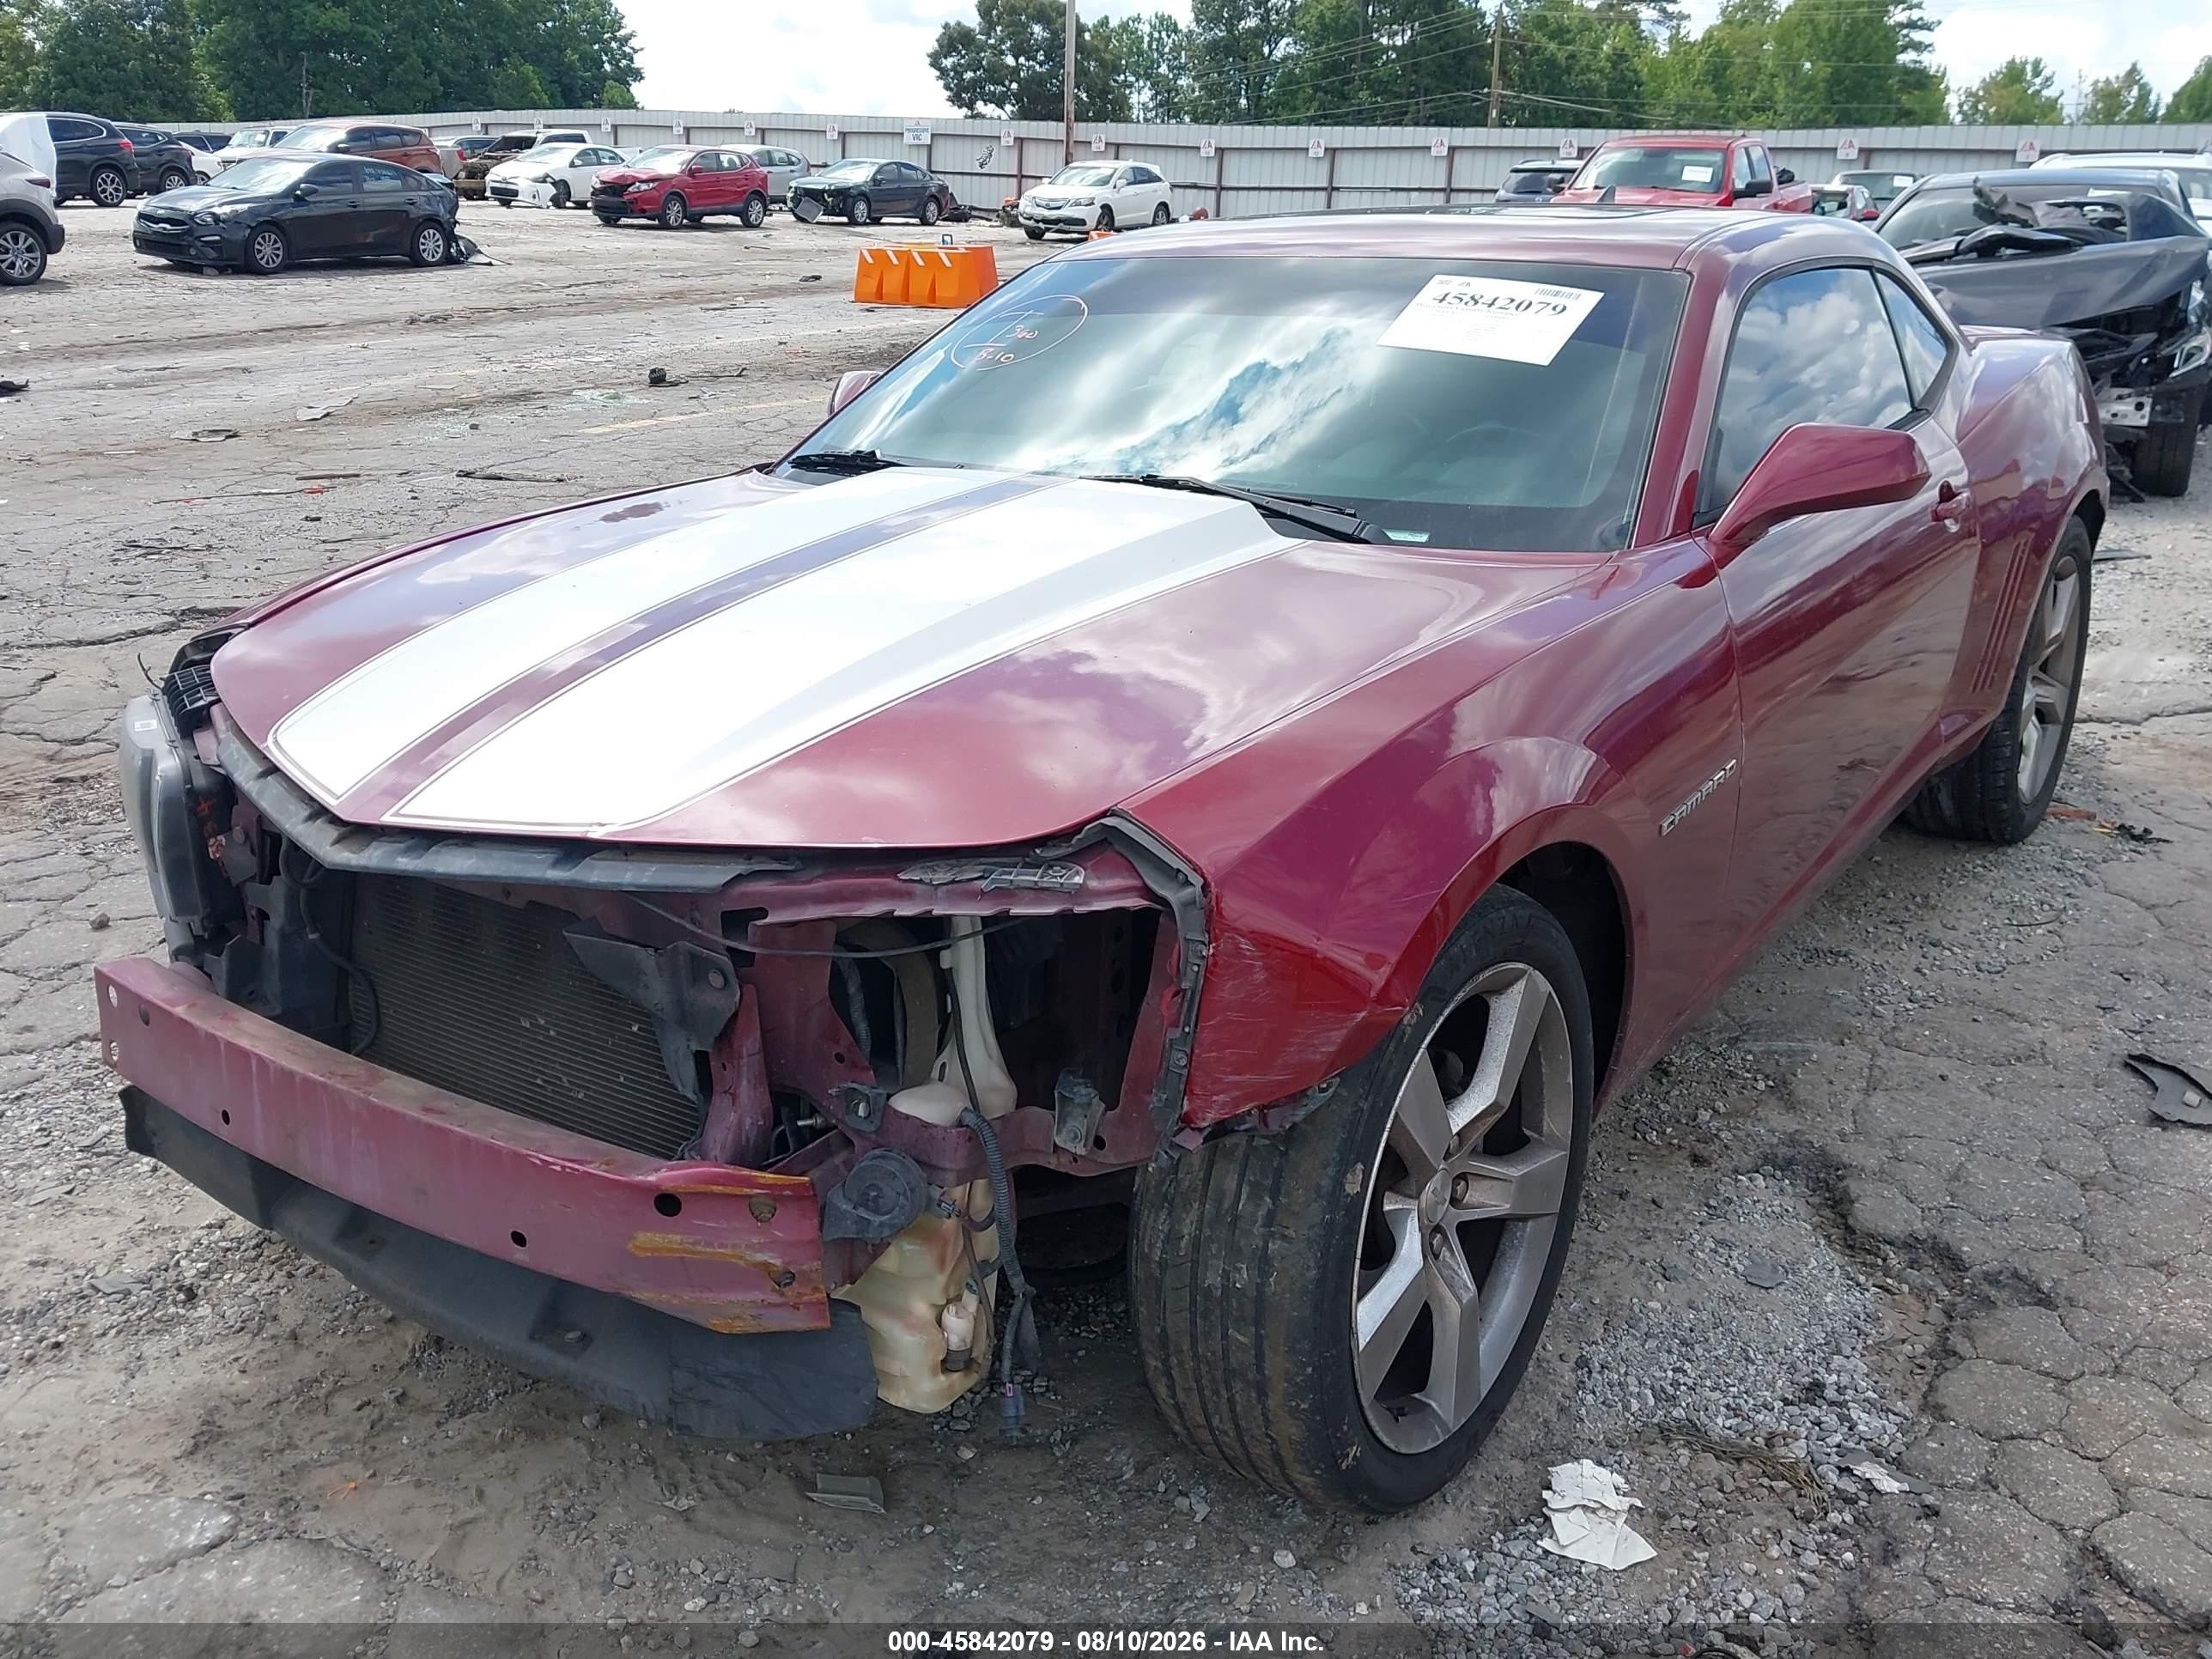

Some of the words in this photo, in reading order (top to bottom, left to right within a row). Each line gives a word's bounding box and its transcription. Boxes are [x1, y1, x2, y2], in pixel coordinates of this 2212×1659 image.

[911, 133, 923, 142] VIC
[1431, 290, 1568, 317] 45842079
[1661, 758, 1737, 836] CAMARO
